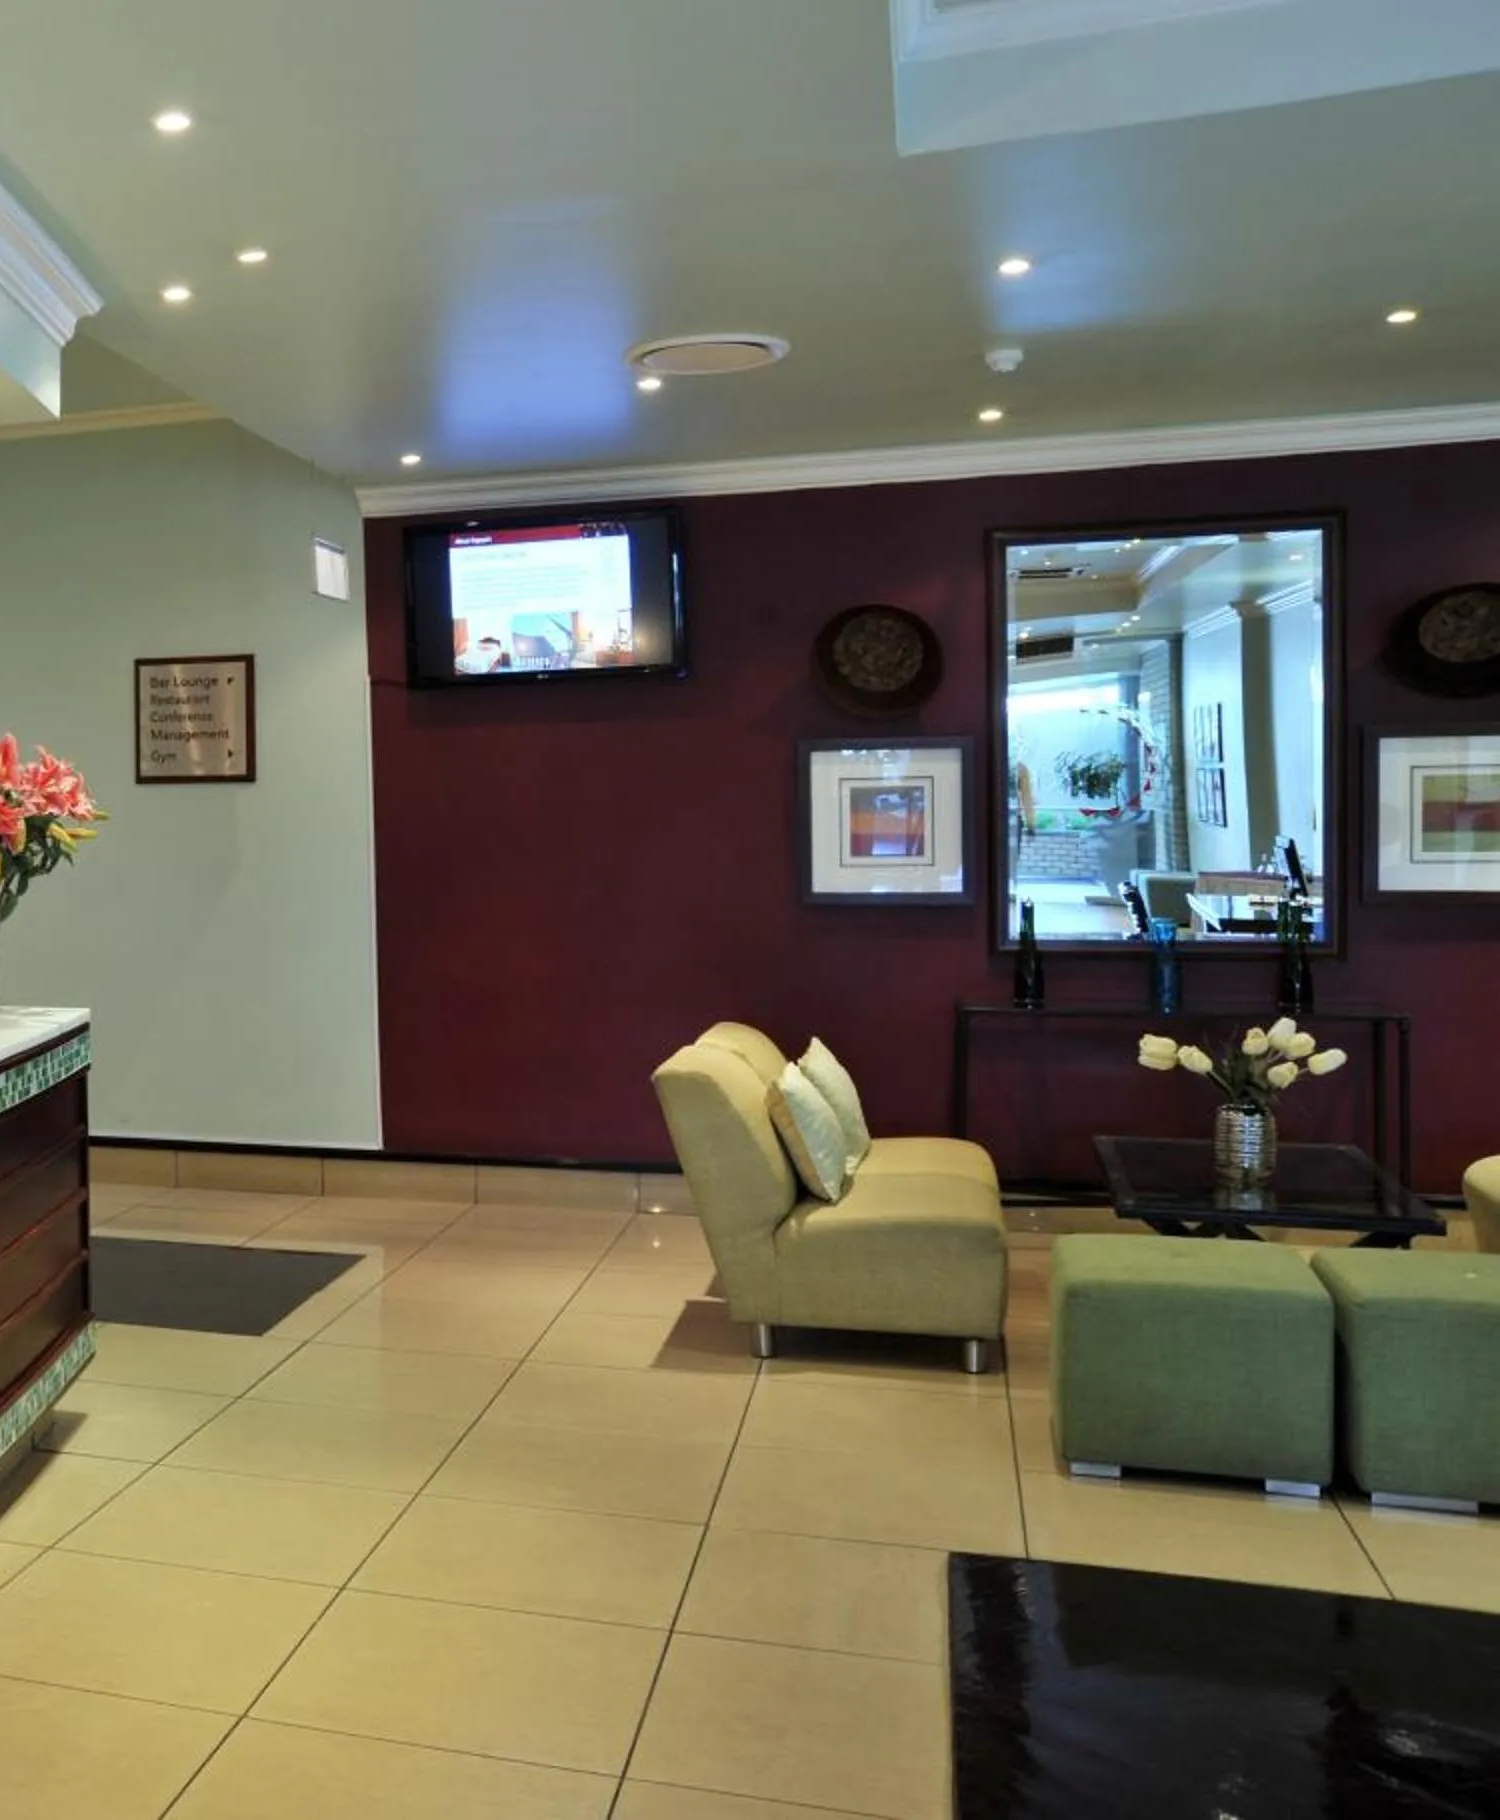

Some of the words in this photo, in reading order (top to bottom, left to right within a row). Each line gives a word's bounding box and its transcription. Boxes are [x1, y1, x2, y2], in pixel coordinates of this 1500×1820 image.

[173, 676, 219, 689] Lounge
[150, 729, 229, 742] Management
[150, 749, 177, 763] Gym
